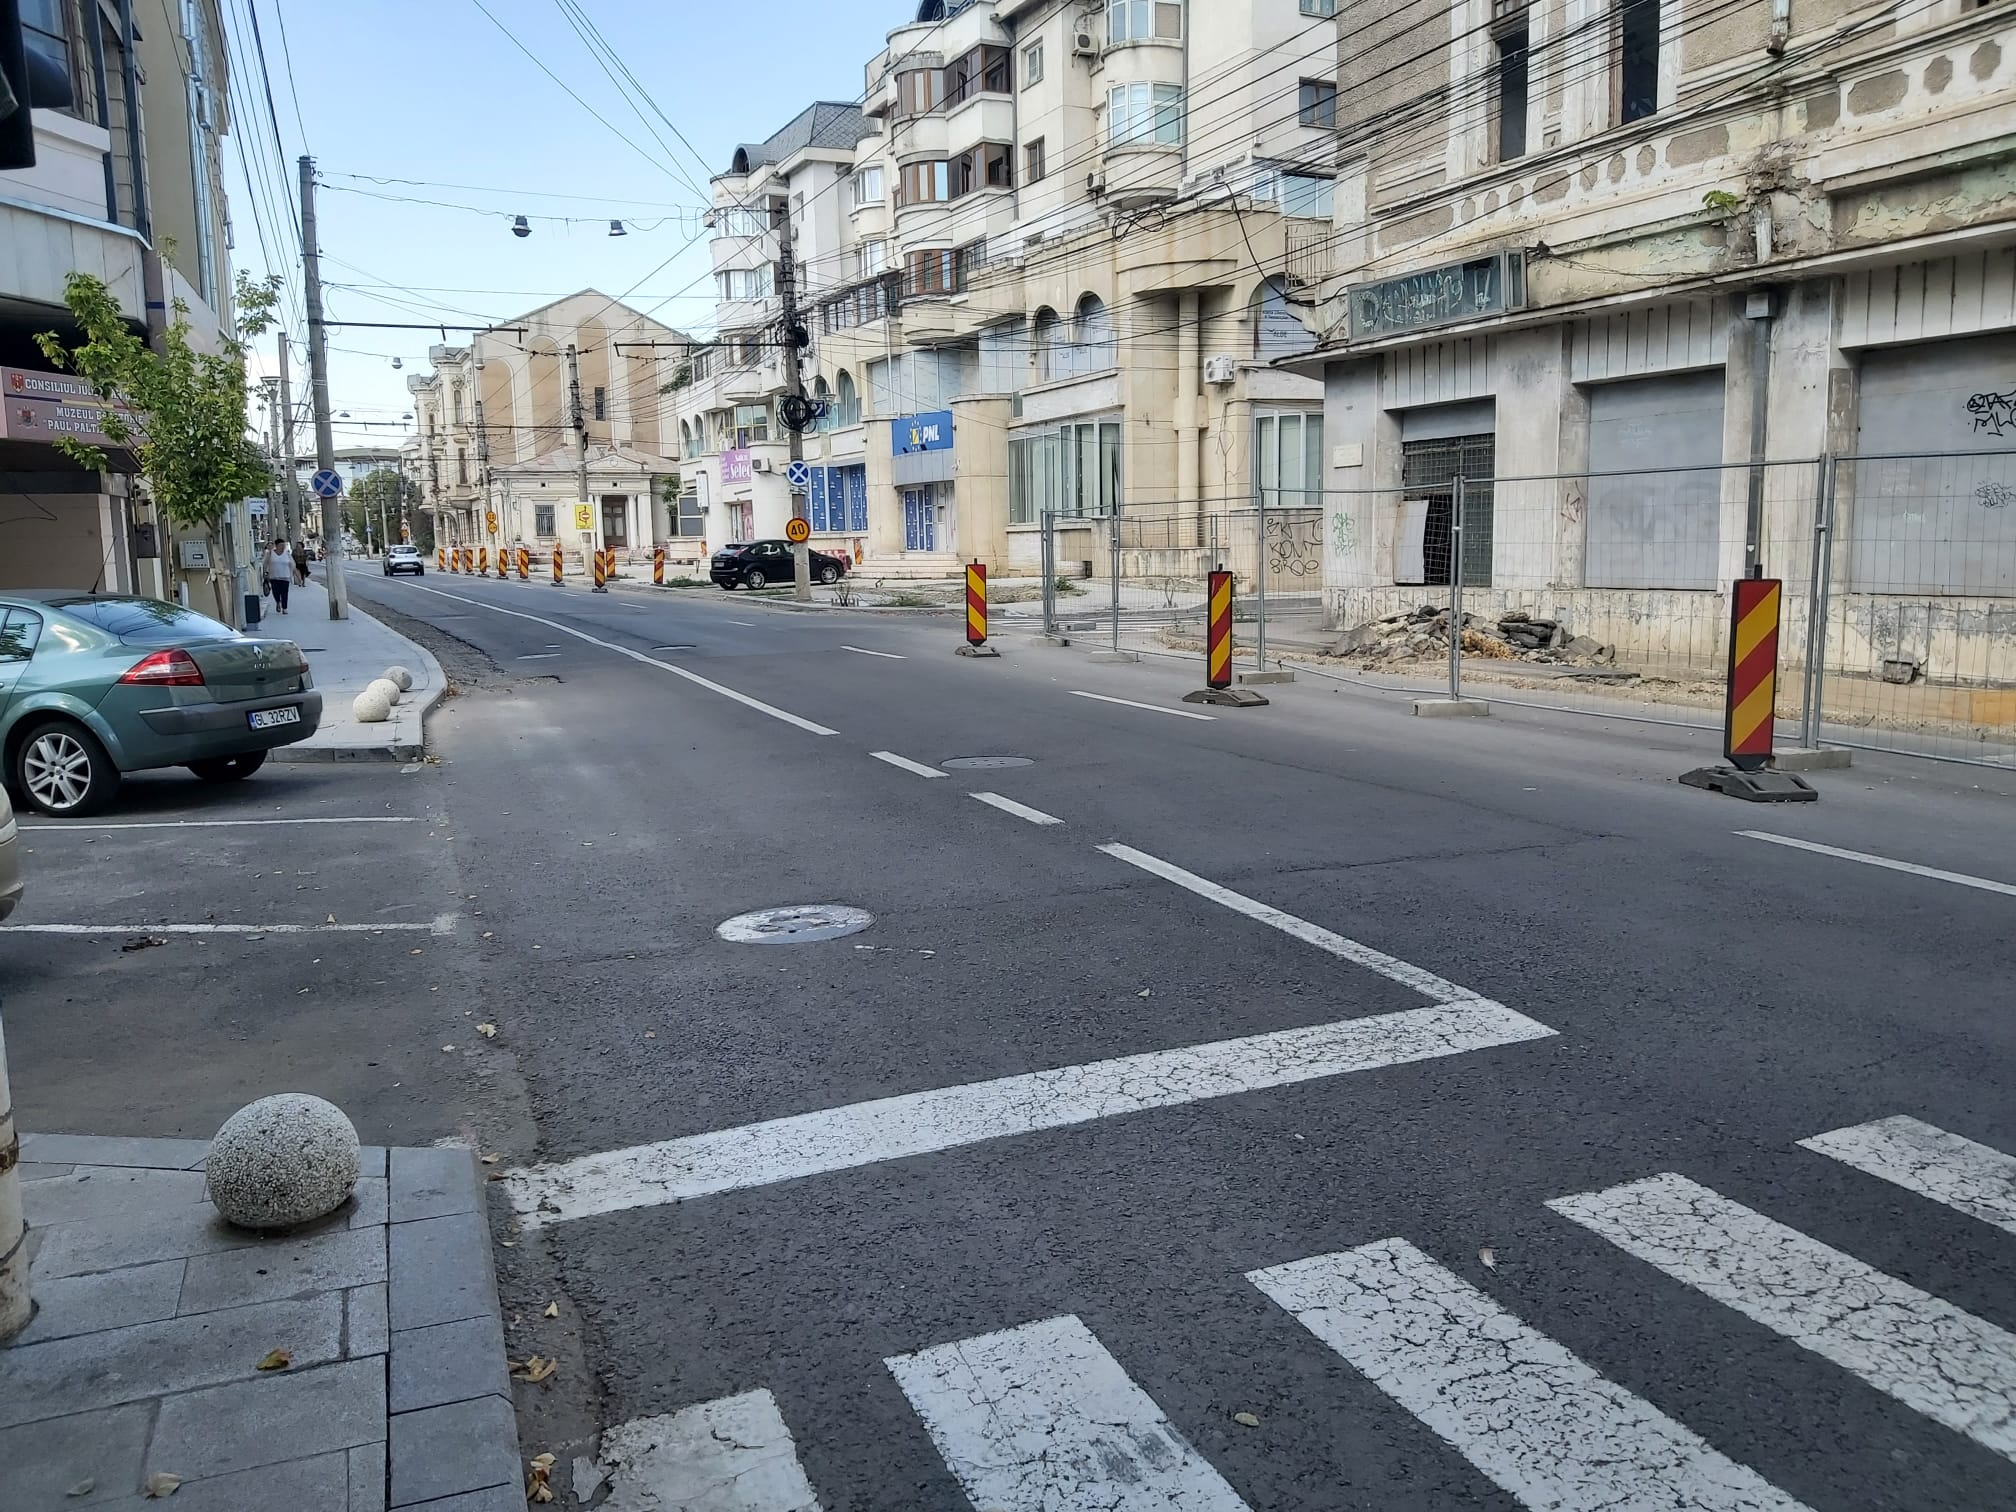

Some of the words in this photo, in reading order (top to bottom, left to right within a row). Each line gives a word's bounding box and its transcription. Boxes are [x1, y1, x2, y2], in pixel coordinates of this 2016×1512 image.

[25, 378, 76, 394] CONSILIUL
[56, 406, 94, 420] MUZEUL
[922, 424, 940, 443] PNL
[791, 523, 805, 535] 40
